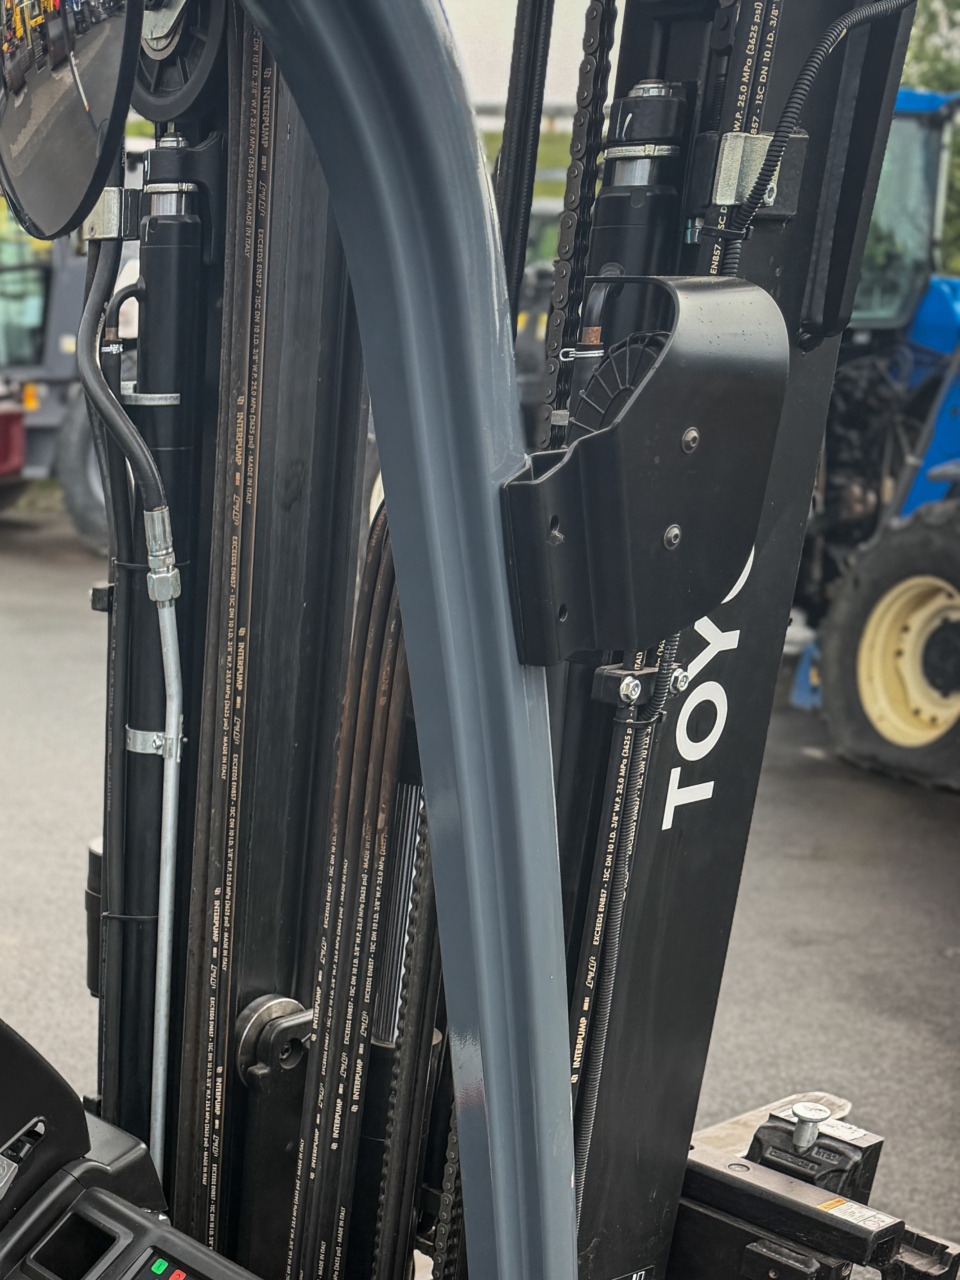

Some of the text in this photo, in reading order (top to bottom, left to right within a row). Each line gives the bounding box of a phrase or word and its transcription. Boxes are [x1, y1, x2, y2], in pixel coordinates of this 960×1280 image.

[751, 1, 764, 23] psi)
[252, 38, 260, 50] DN
[745, 25, 760, 55] (3625
[252, 54, 259, 63] 10
[762, 51, 771, 62] 10
[740, 58, 753, 82] MPa
[758, 66, 769, 84] DN
[261, 86, 271, 148] INTERPUMP
[731, 110, 743, 131] W.P.
[248, 136, 256, 154] MPa
[247, 156, 255, 178] (3625
[246, 179, 254, 194] psi)
[245, 202, 253, 226] MADE
[245, 227, 252, 236] IN
[244, 238, 252, 258] ITALY
[256, 229, 265, 262] EXCEEDS
[710, 244, 723, 275] EN857
[255, 264, 263, 287] EN857
[253, 310, 261, 323] DN
[253, 325, 260, 333] 10
[249, 397, 257, 413] MPa
[248, 415, 257, 434] (3625
[235, 412, 245, 465] INTERPUMP
[247, 436, 256, 449] psi)
[246, 456, 254, 476] MADE
[246, 478, 253, 486] IN
[245, 487, 253, 504] ITALY
[662, 545, 755, 830] TOY
[620, 735, 632, 757] (3625
[618, 759, 628, 777] MPa
[613, 795, 622, 812] W.P.
[606, 844, 615, 852] 10
[604, 854, 613, 866] DN
[597, 889, 607, 912] EN857
[593, 913, 604, 945] EXCEEDS
[572, 1017, 588, 1069] INTERPUMP
[352, 1058, 364, 1100] INTERPUMP
[214, 1077, 223, 1115] INTERPUMP
[331, 1098, 344, 1138] INTERPUMP
[310, 1128, 320, 1168] INTERPUMP
